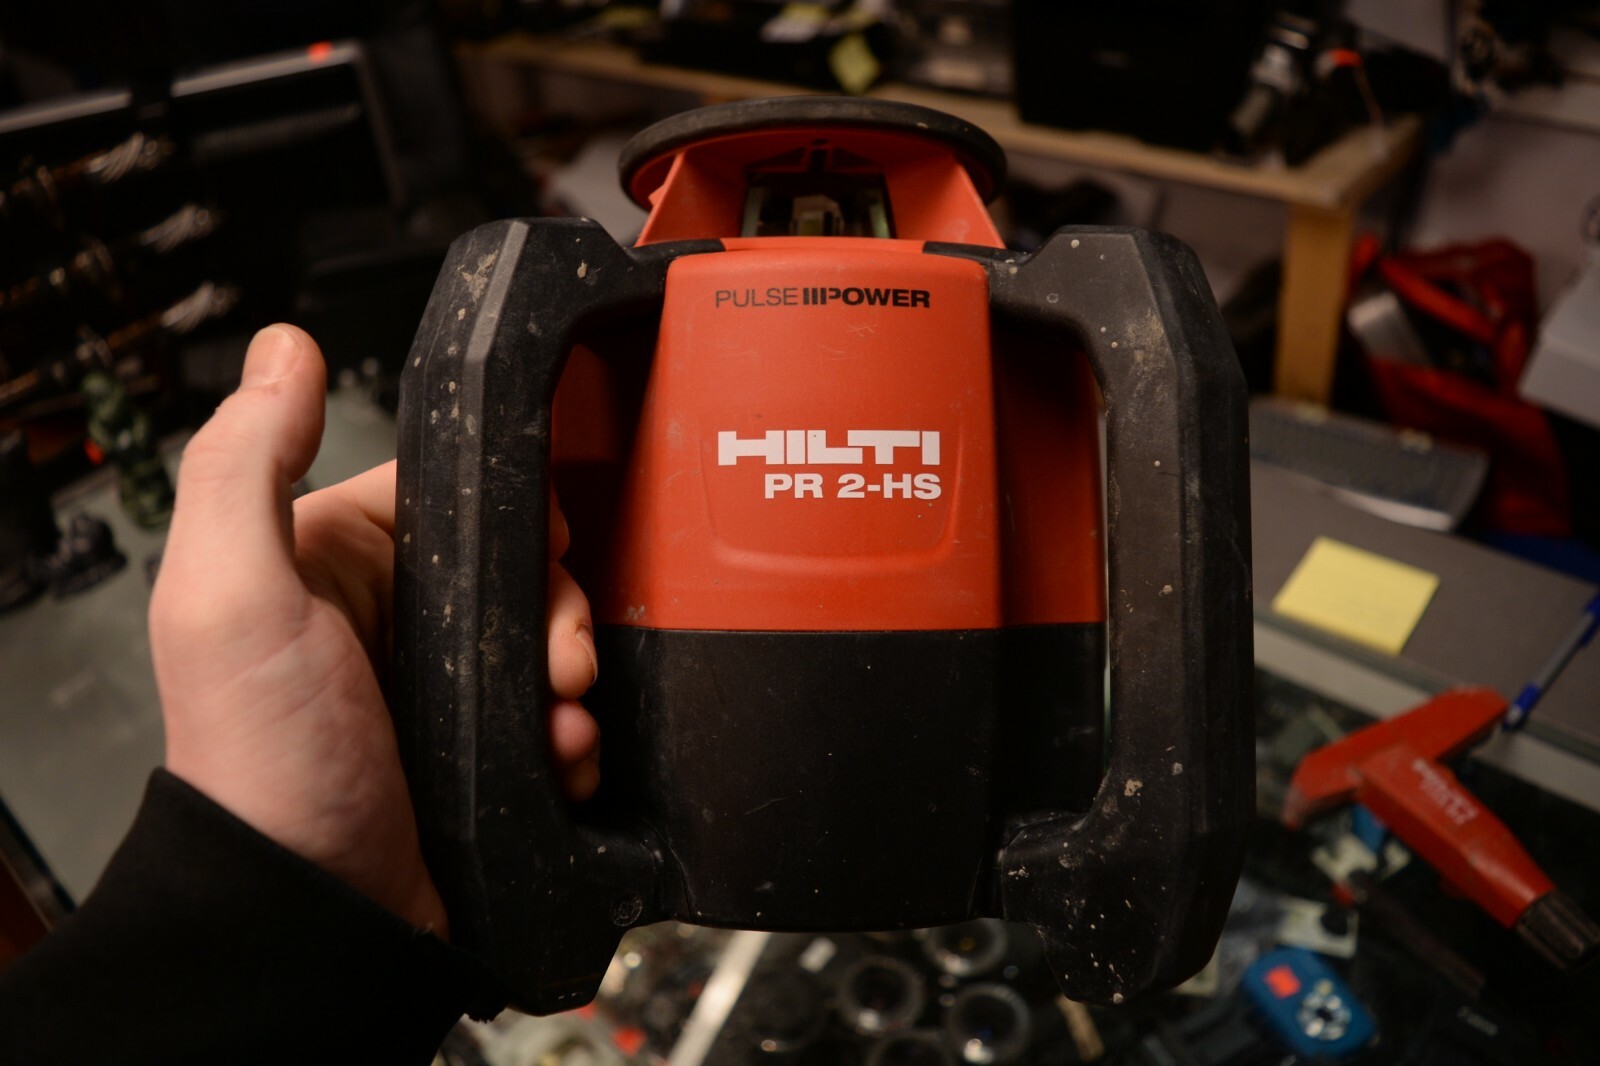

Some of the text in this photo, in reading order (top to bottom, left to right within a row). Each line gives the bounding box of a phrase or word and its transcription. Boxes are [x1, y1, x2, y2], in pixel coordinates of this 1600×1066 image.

[715, 287, 798, 308] PULSE
[717, 429, 940, 466] HILTI
[764, 473, 942, 500] PR 2-HS
